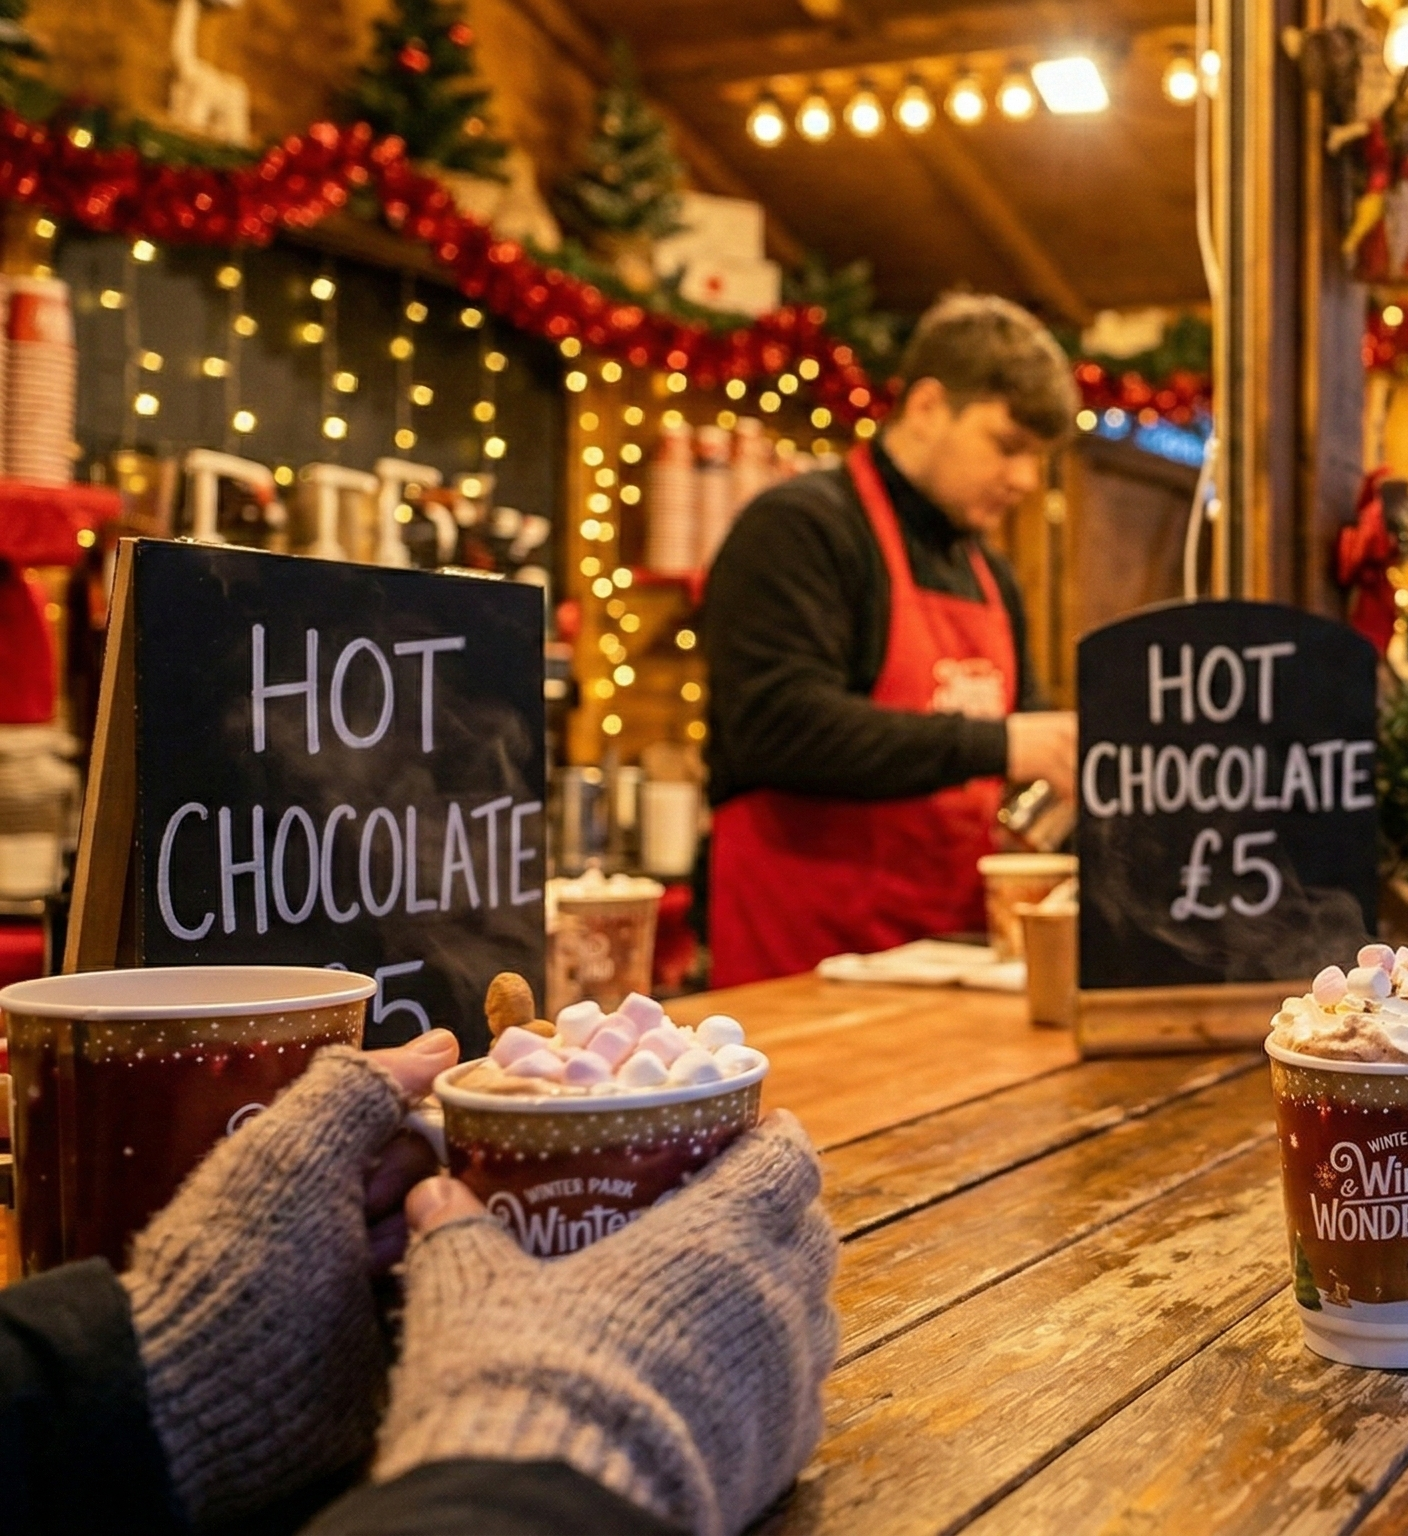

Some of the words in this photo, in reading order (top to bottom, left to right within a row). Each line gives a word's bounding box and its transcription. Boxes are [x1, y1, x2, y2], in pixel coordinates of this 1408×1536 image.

[251, 622, 466, 755] HOT
[1147, 642, 1297, 724] HOT
[1082, 739, 1376, 816] CHOCOLATE
[157, 796, 541, 941] CHOCOLATE
[1170, 828, 1284, 920] £5
[487, 1191, 640, 1256] Winte
[523, 1178, 584, 1204] WINTER
[588, 1177, 637, 1199] PARK
